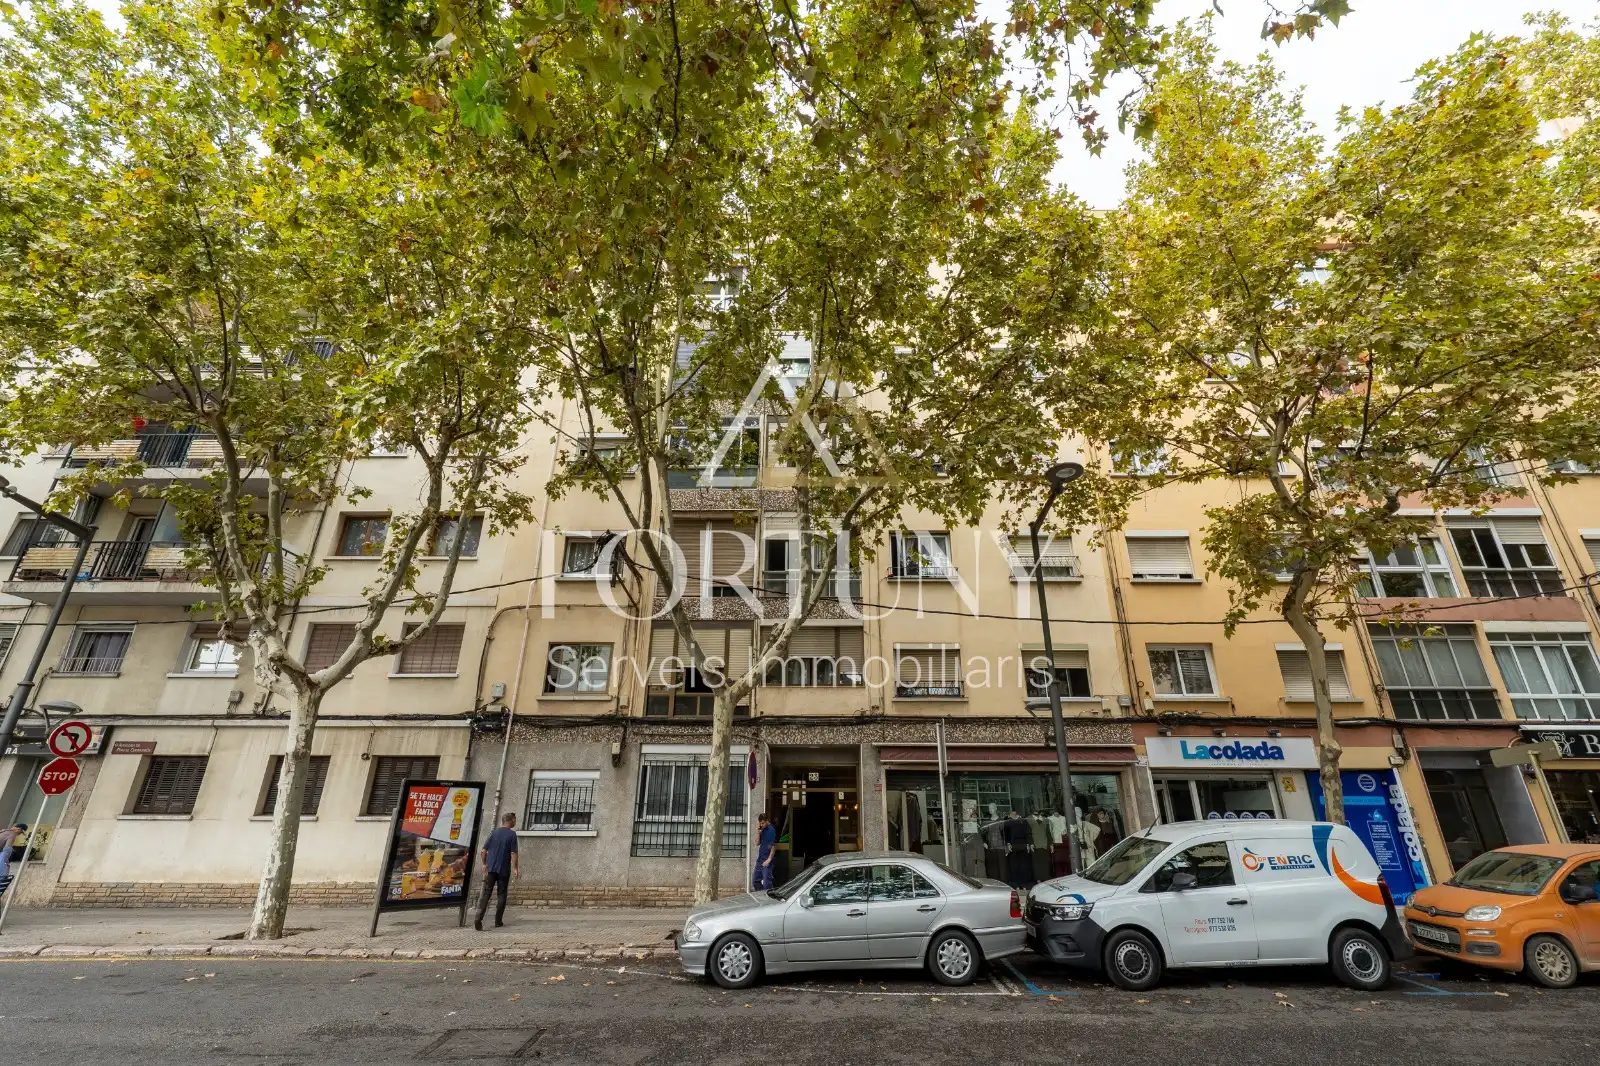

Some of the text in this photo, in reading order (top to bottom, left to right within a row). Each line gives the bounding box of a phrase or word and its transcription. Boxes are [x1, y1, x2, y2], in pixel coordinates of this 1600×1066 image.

[1180, 740, 1284, 760] Lacolada
[43, 772, 76, 780] STOP
[419, 792, 427, 800] TE
[427, 793, 443, 801] HACE
[413, 800, 422, 808] LA
[441, 885, 461, 894] FANTA
